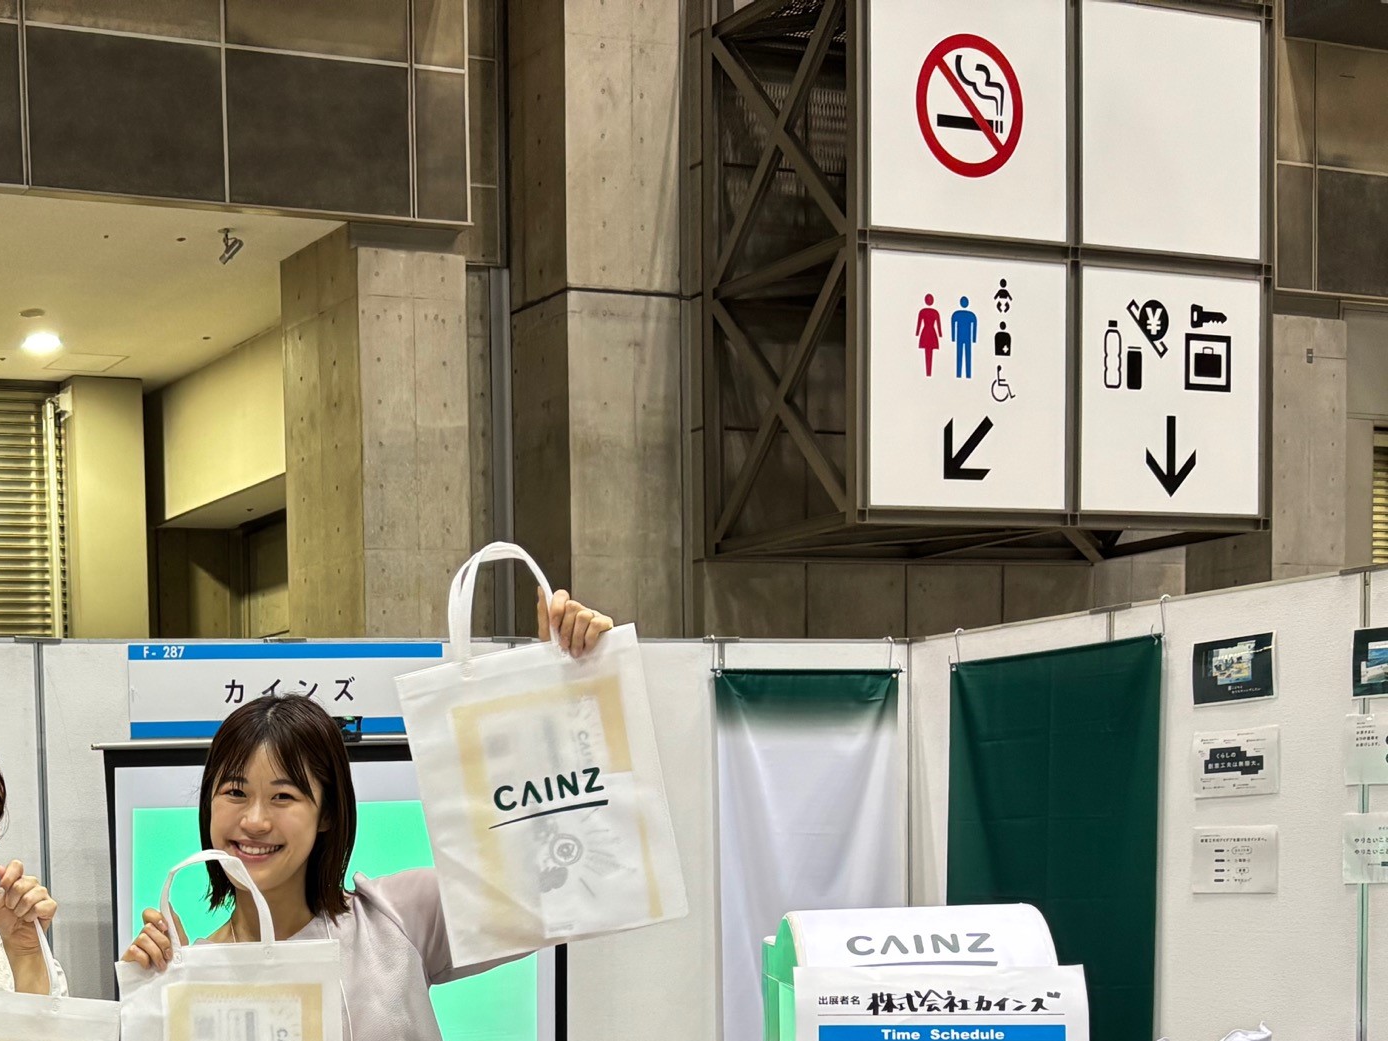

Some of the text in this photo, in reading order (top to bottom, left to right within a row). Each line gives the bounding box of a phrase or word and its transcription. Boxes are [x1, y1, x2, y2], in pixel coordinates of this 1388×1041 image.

[162, 645, 185, 659] 287
[224, 676, 356, 704] カインズ
[493, 766, 606, 813] CAINZ
[846, 932, 995, 957] CAINZ
[818, 989, 1062, 1016] 出展者名 株式会社カインズ
[881, 1028, 1005, 1040] Time Schedule
